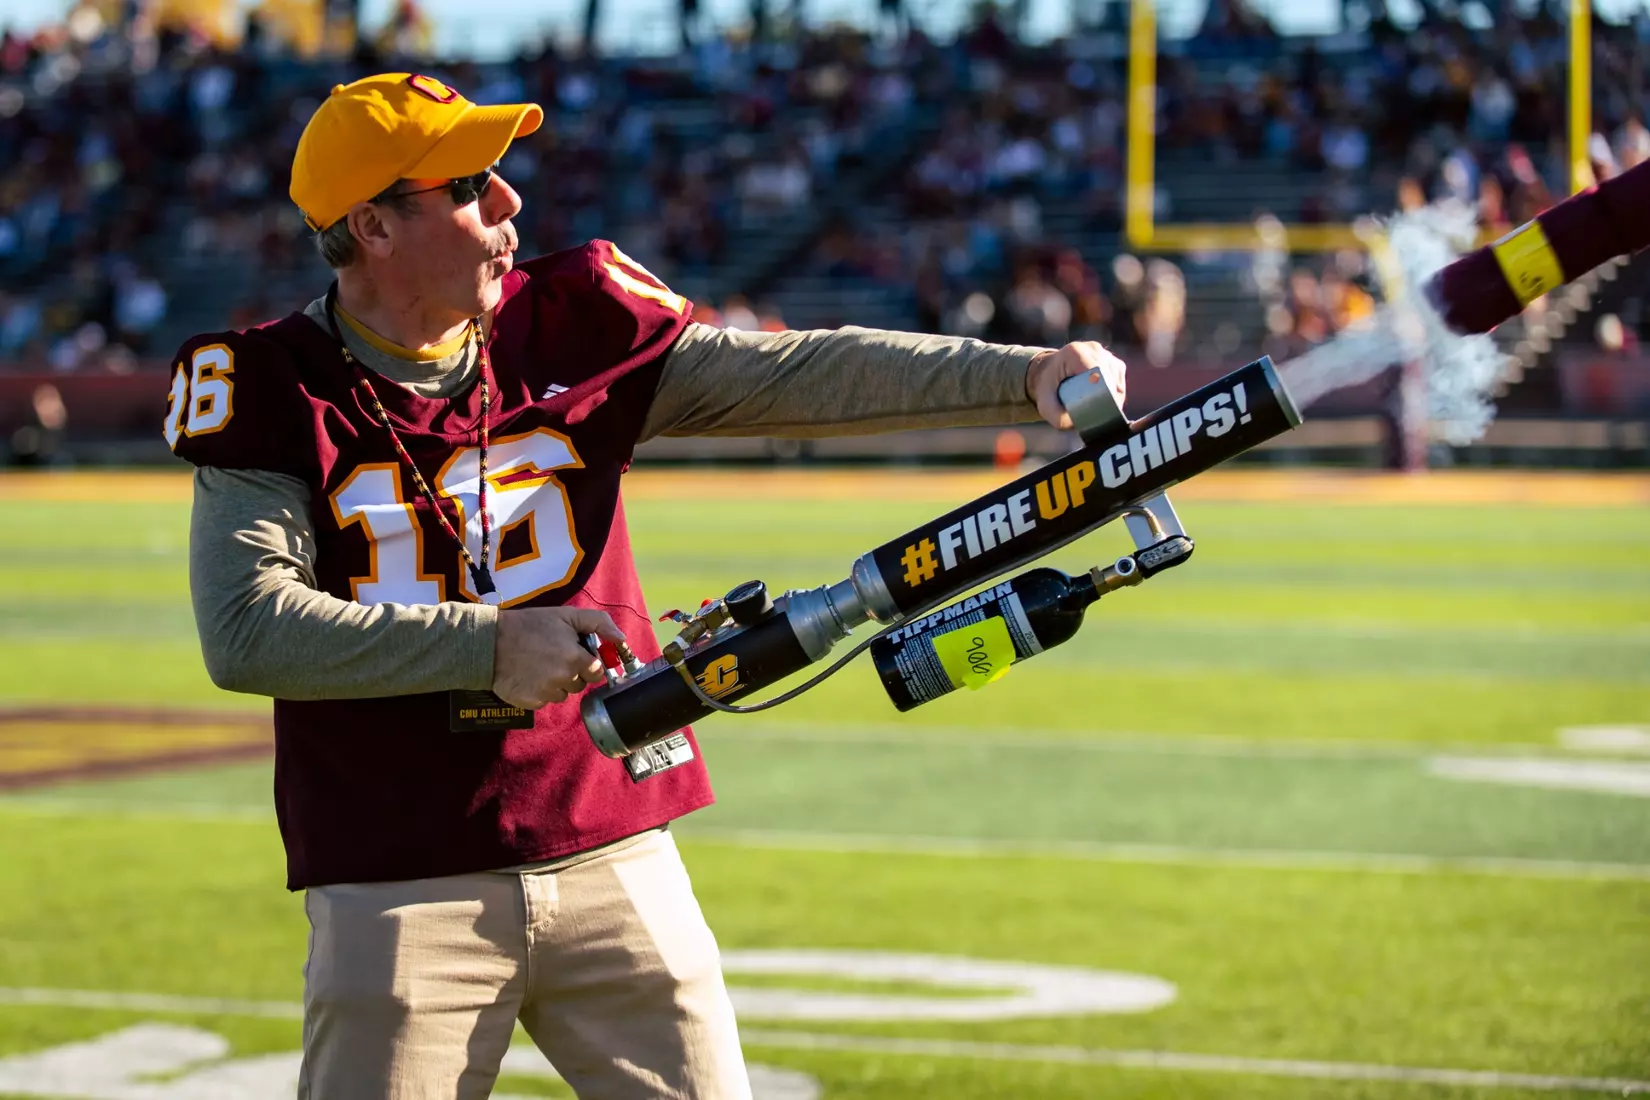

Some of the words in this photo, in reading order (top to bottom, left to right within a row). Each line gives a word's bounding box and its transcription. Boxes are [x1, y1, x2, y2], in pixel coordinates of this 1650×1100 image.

[162, 343, 235, 452] 16
[328, 426, 586, 609] 16
[886, 581, 1014, 645] TIPPMANN
[459, 708, 478, 719] CMU
[480, 707, 526, 719] ATHLETICS
